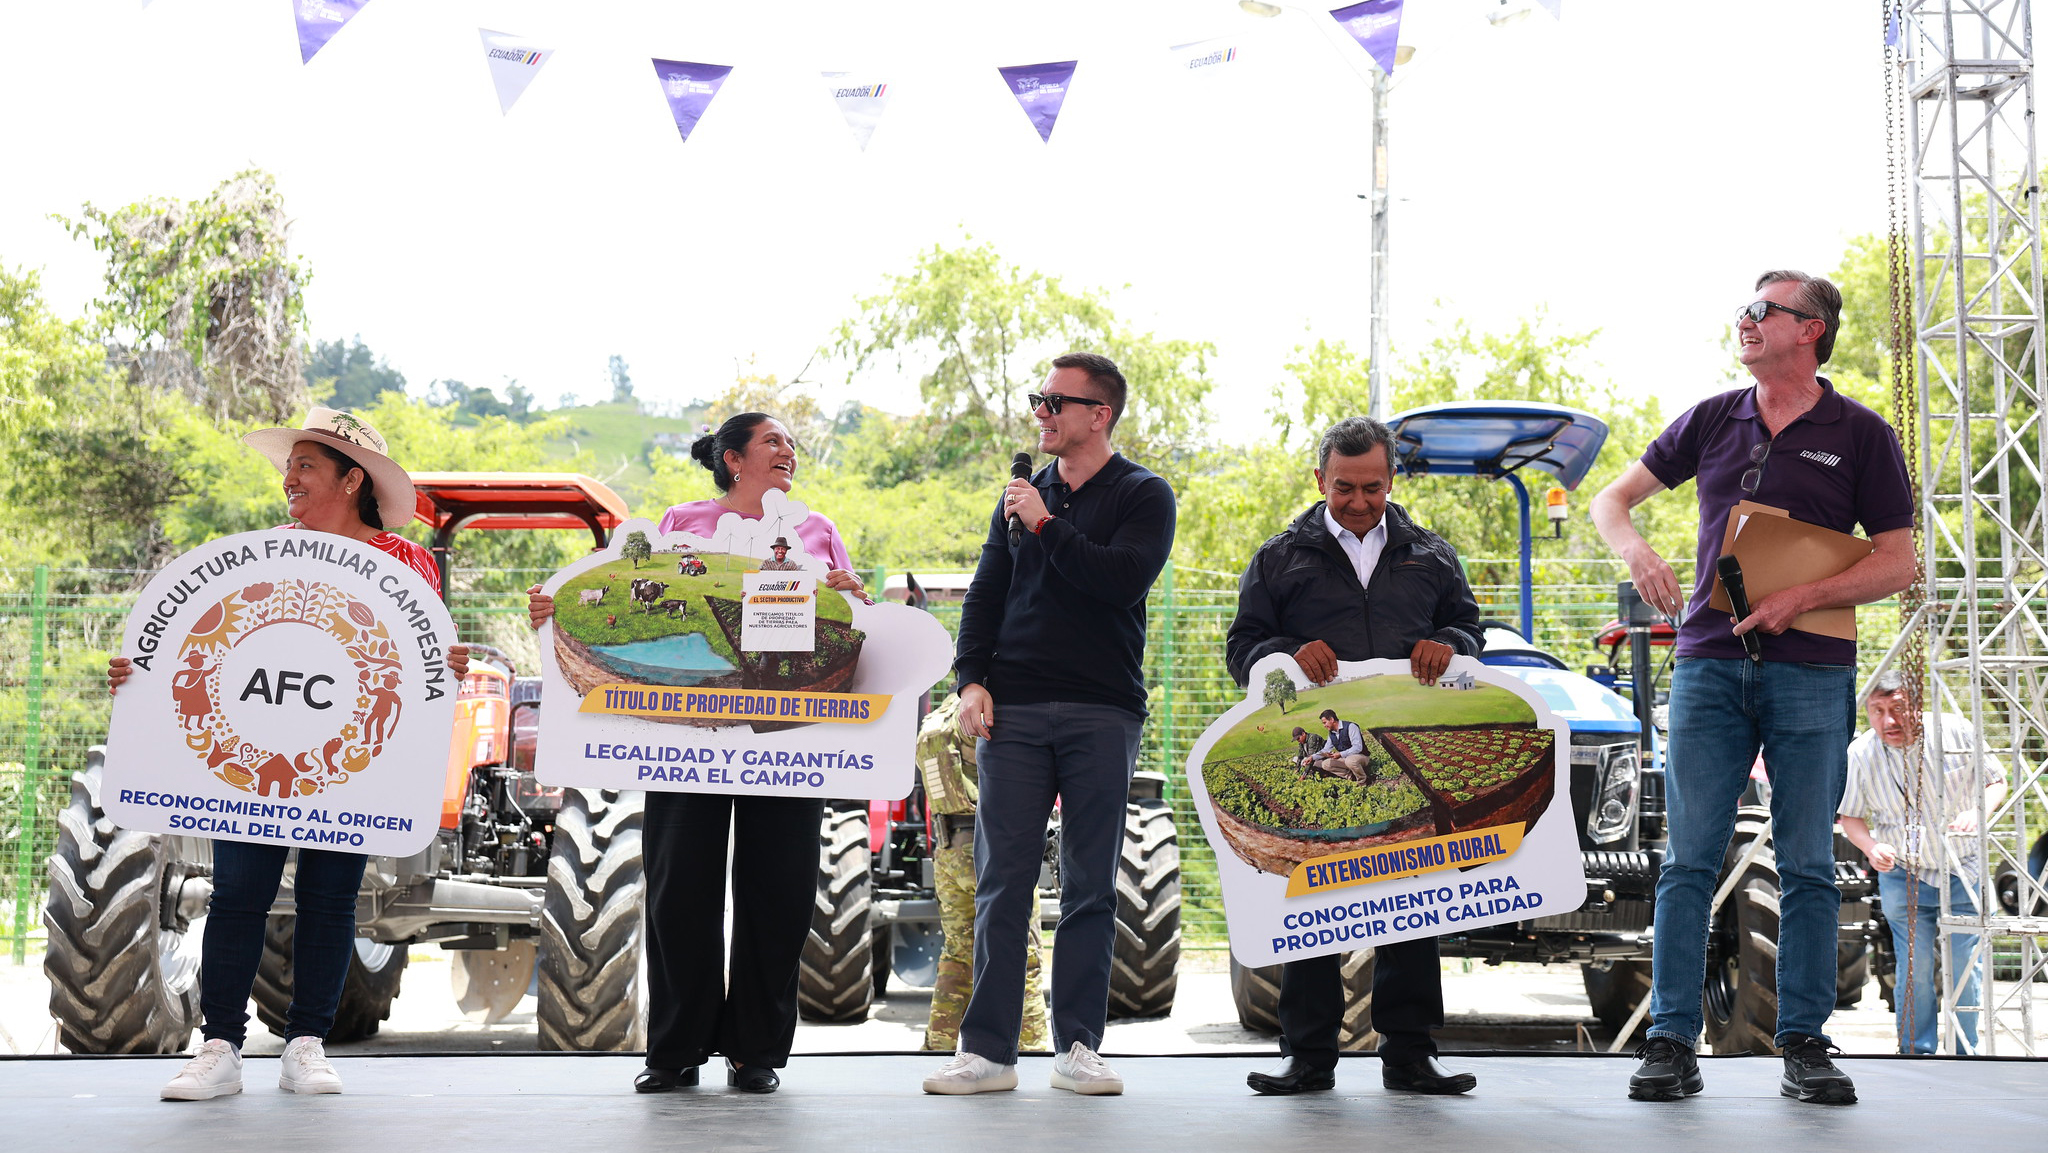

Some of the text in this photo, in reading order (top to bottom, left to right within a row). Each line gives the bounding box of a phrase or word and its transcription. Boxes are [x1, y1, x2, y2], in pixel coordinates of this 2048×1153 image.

[489, 49, 524, 62] ECUADOR
[1190, 54, 1222, 69] ECUADOR
[836, 87, 870, 98] ECUADOR
[1800, 450, 1828, 463] ECUADOR
[132, 538, 445, 702] AGRICULTURA FAMILIAR CAMPESINA
[239, 668, 336, 710] AFC
[604, 686, 870, 719] TÍTULO DE PROPIEDAD DE TIERRAS
[584, 743, 874, 770] LEGALIDAD Y GARANTÍAS
[637, 765, 825, 788] PARA EL CAMPO
[119, 789, 413, 832] RECONOCIMIENTO AL ORIGEN
[169, 814, 365, 847] SOCIAL DEL CAMPO
[1305, 833, 1507, 888] EXTENSIONISMO RURAL
[1283, 874, 1520, 931] CONOCIMIENTO PARA
[1271, 892, 1544, 954] PRODUCIR CON CALIDAD
